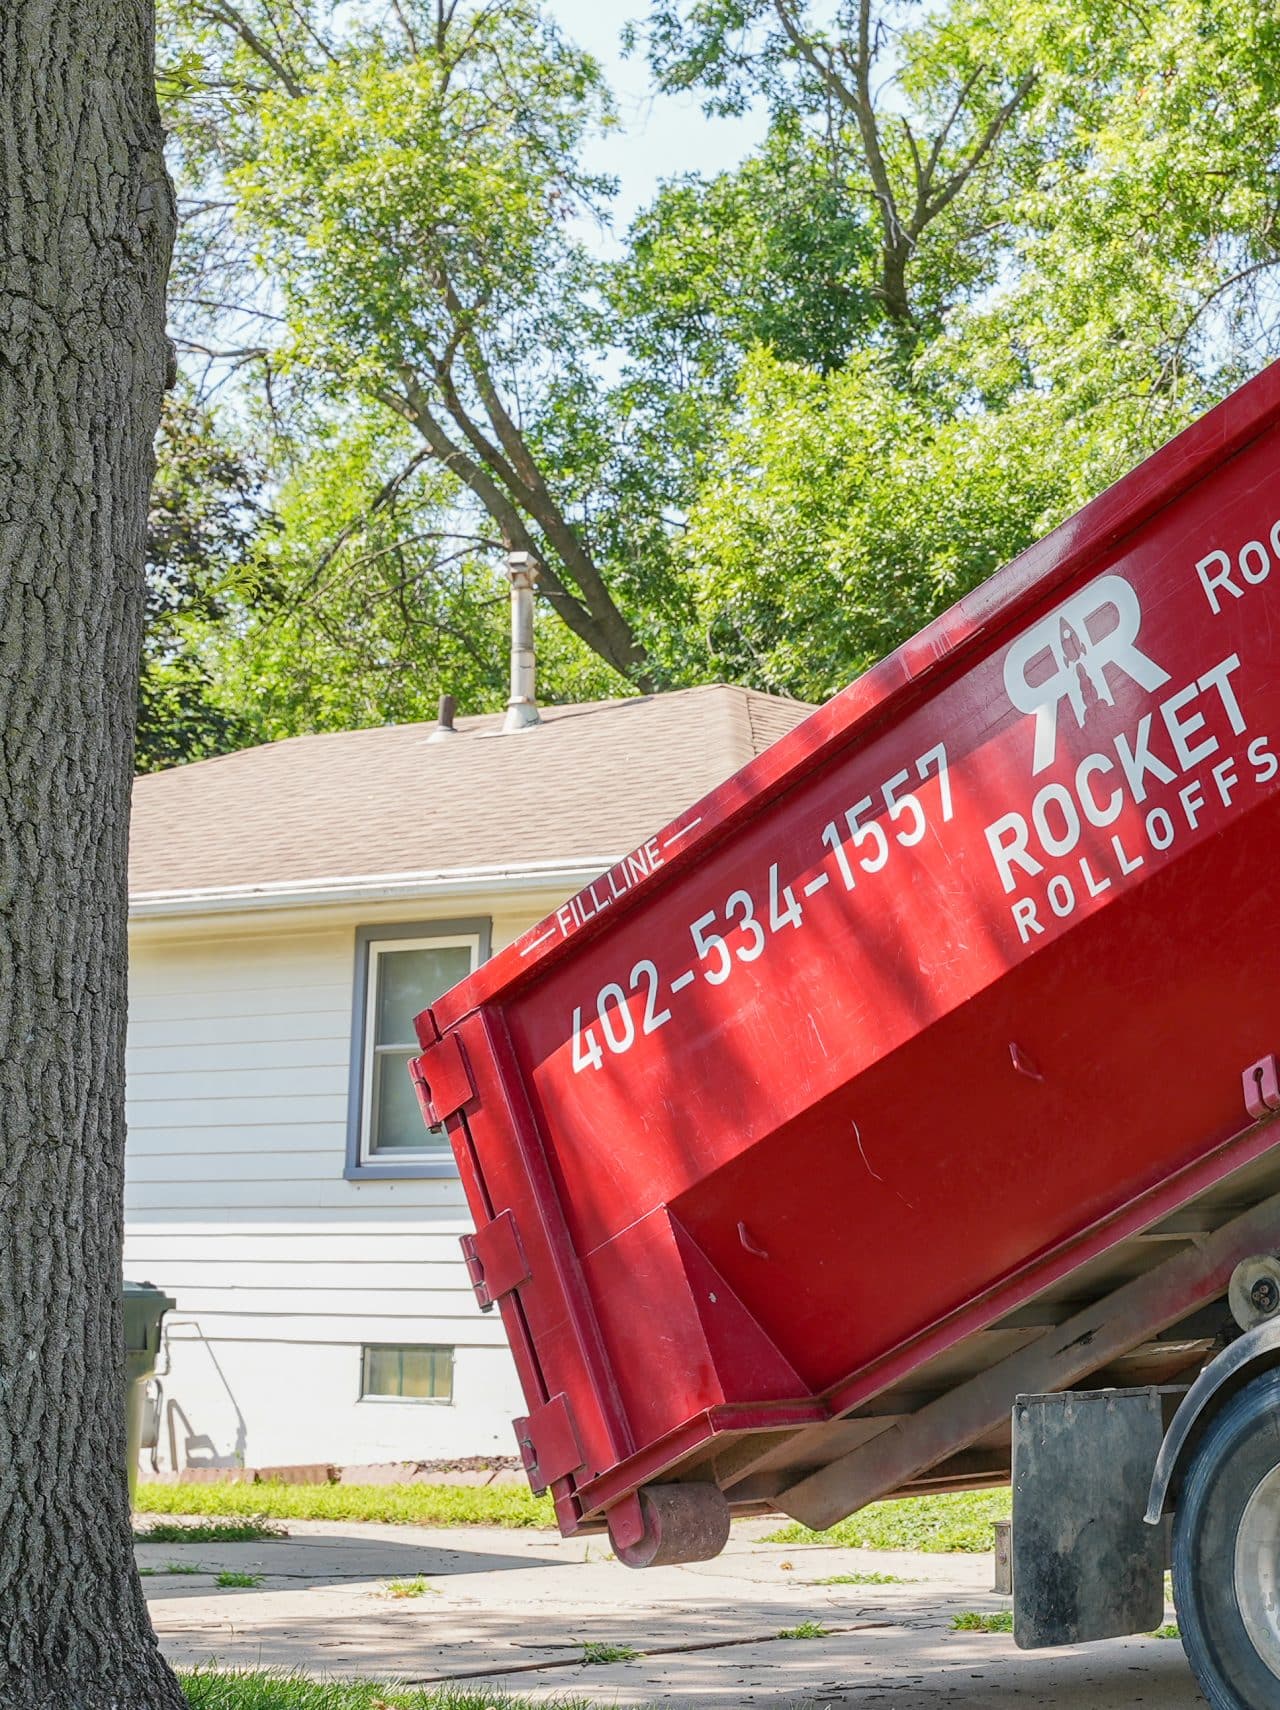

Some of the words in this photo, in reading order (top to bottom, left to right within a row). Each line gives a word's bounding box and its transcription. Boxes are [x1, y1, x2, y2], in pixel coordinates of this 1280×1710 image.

[984, 653, 1247, 895] ROCKET
[1011, 737, 1280, 944] ROLLOFFS
[556, 884, 610, 937] FILL
[606, 836, 665, 899] LINE
[570, 741, 954, 1075] 402-534-1557
